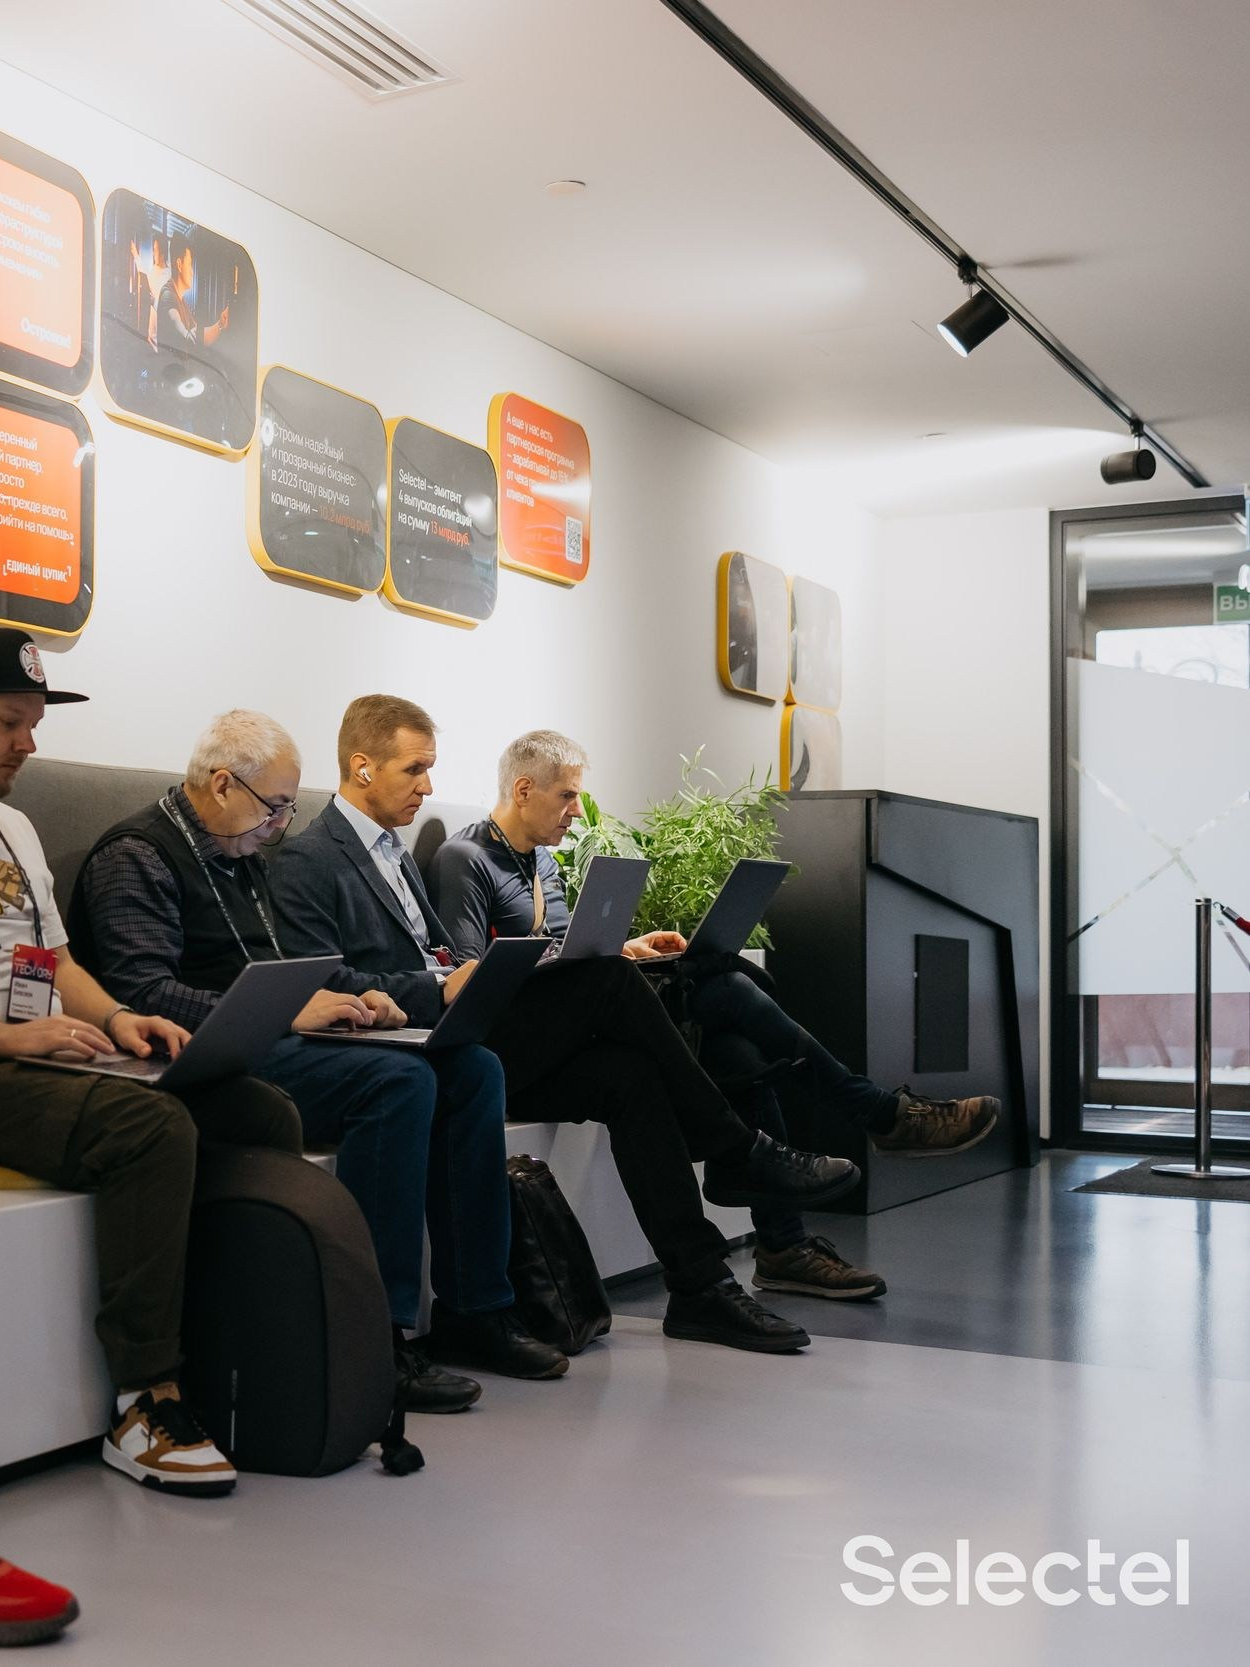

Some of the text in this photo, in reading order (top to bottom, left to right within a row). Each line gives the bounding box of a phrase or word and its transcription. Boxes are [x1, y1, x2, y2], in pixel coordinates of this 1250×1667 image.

[540, 428, 554, 443] есть
[305, 438, 344, 462] надежный
[506, 433, 575, 471] партнерская программа
[271, 449, 278, 459] и
[278, 450, 326, 477] прозрачный
[271, 469, 350, 507] в 2023 году выручка
[399, 468, 427, 492] Selectel
[434, 485, 463, 505] эмитент
[7, 497, 41, 514] прежде
[271, 492, 311, 515] компании
[398, 489, 472, 527] 4 выпусков облигаций
[24, 521, 35, 531] на
[398, 512, 407, 525] на
[407, 516, 431, 536] сумму
[431, 520, 439, 534] 13
